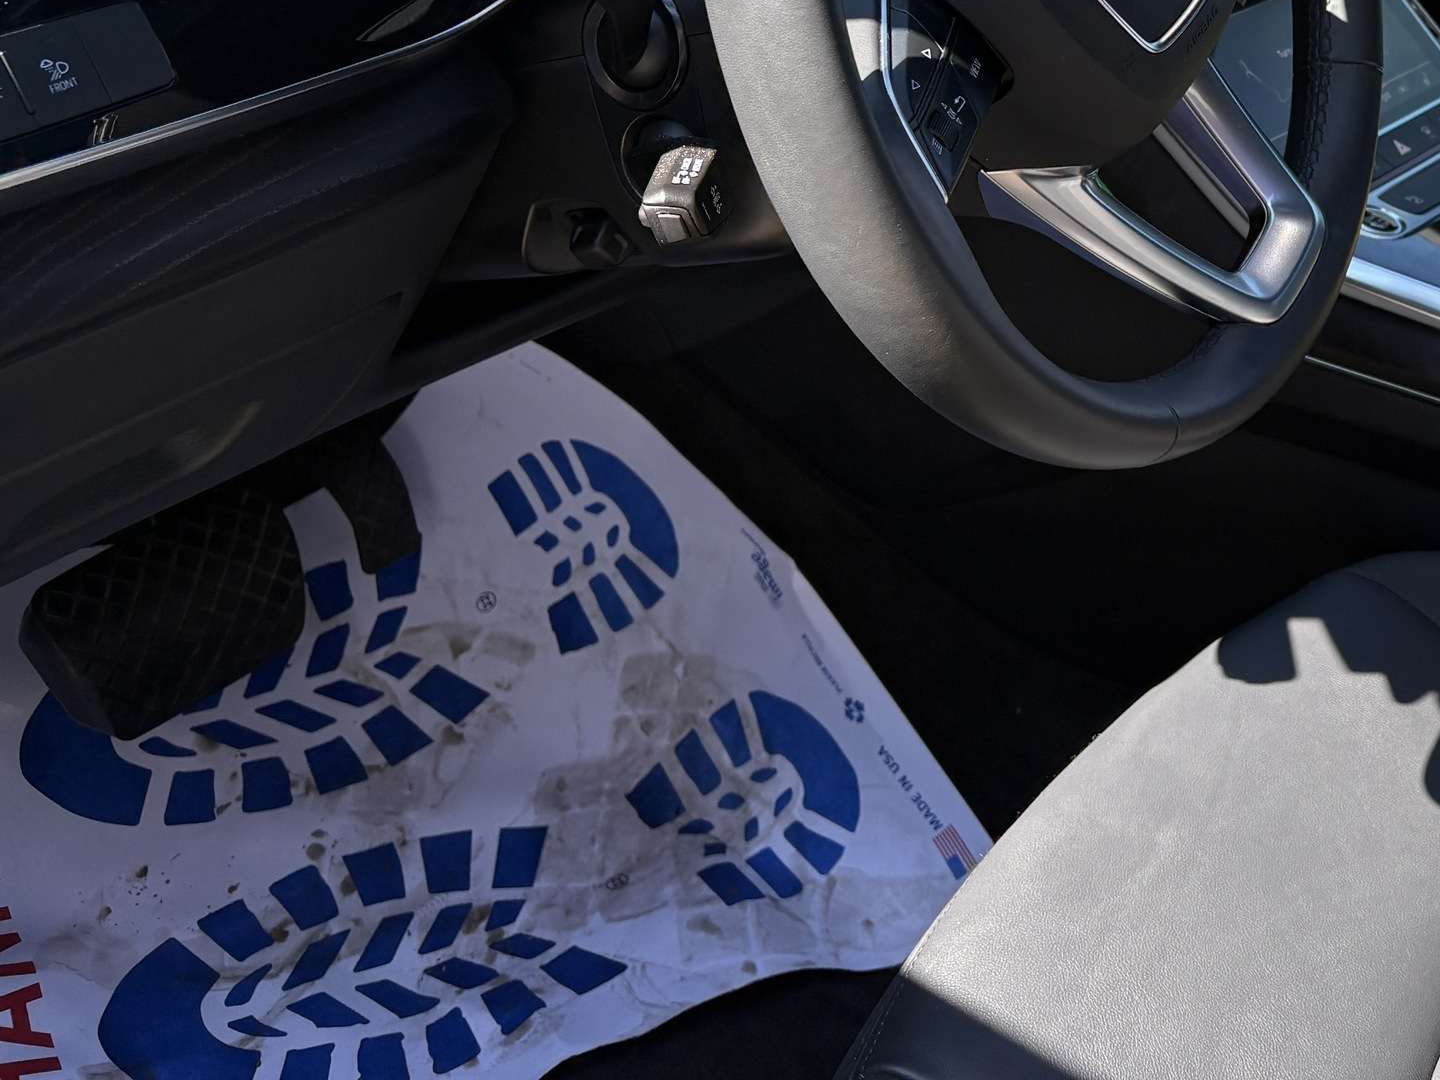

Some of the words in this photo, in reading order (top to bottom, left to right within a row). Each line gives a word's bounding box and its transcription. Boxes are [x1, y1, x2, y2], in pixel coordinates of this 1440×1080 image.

[48, 77, 79, 94] FRONT
[878, 744, 900, 774] USA
[898, 774, 914, 792] IN
[911, 792, 944, 831] MADE
